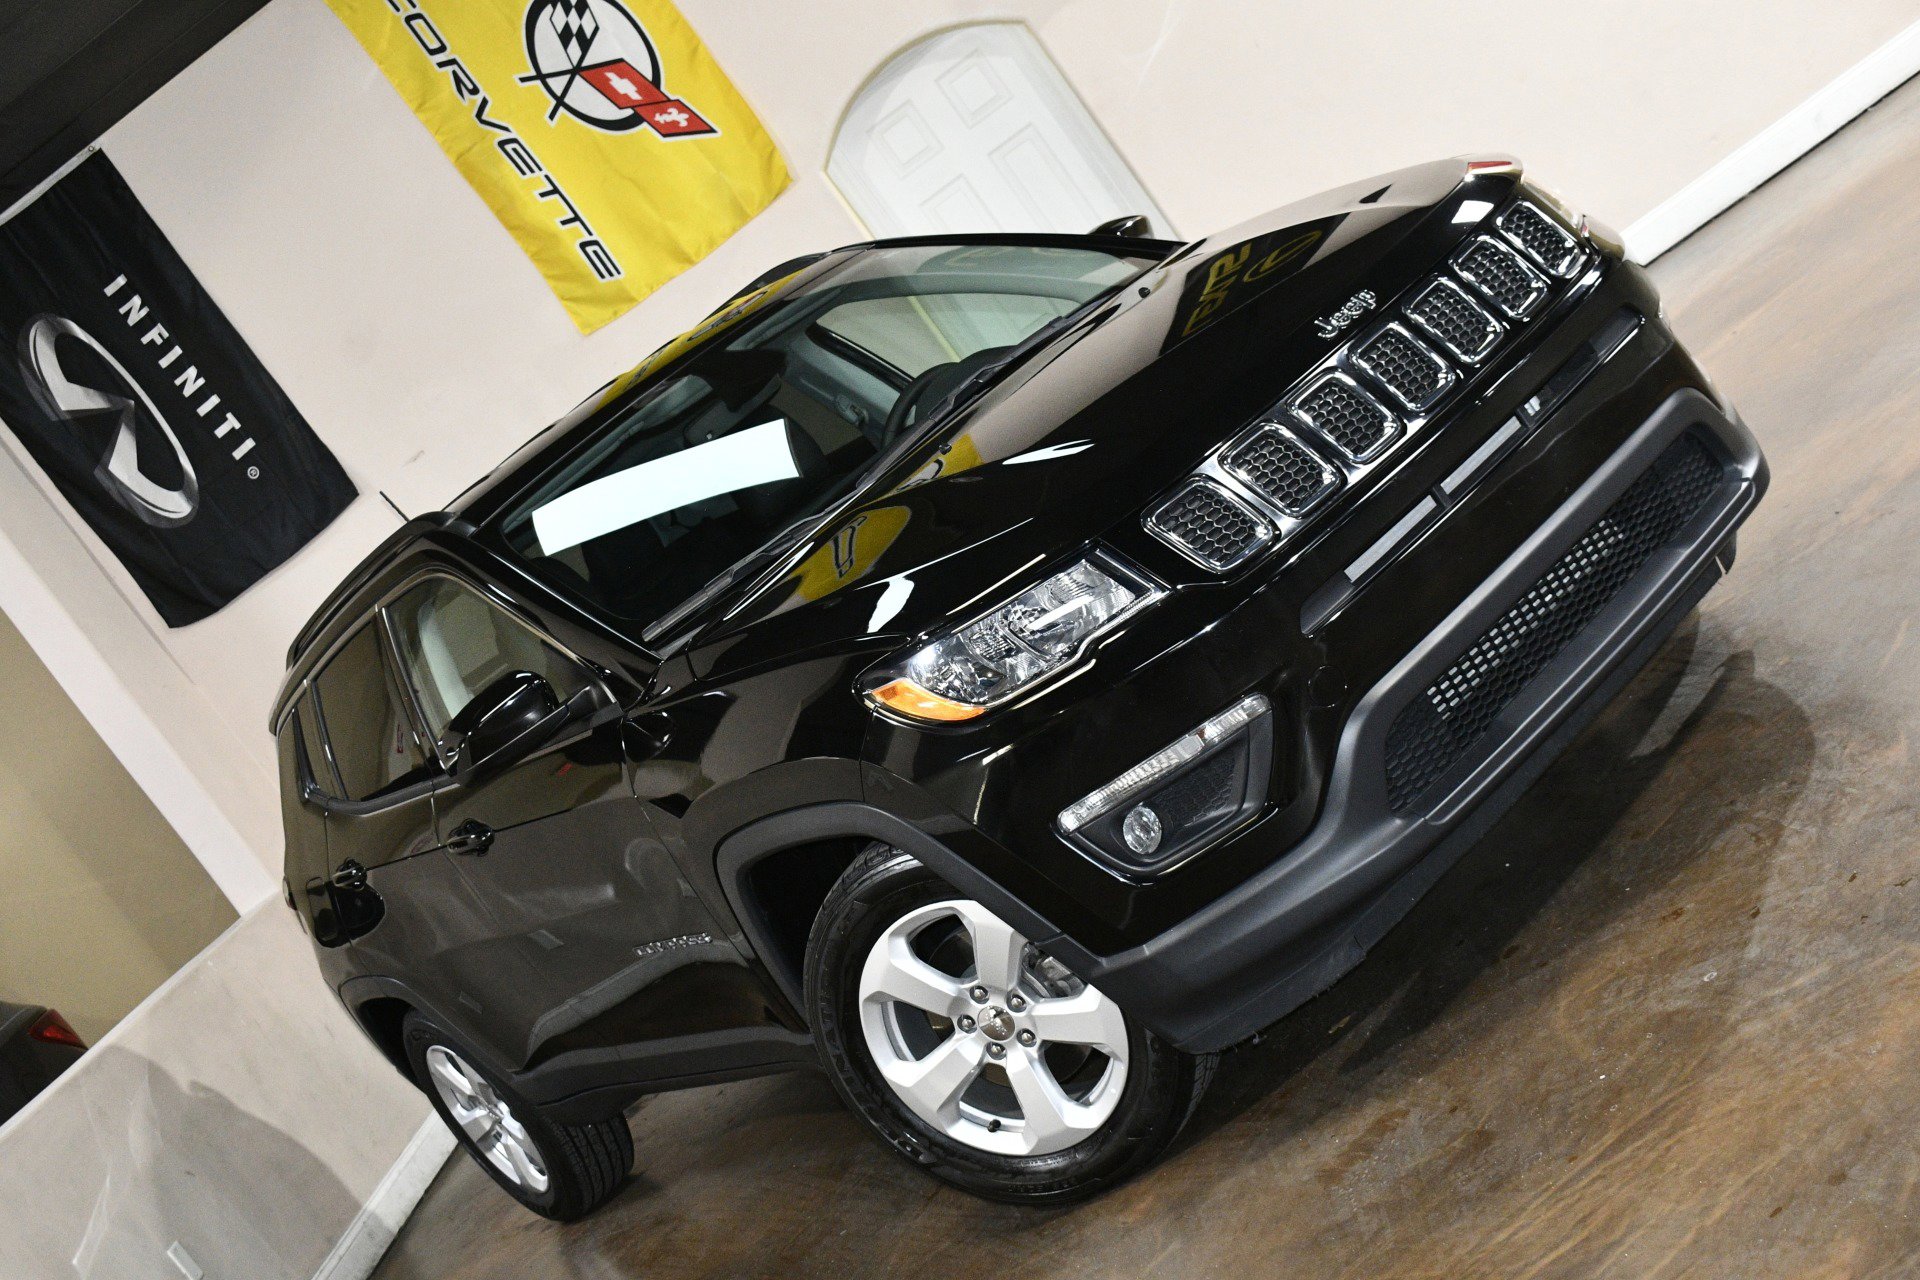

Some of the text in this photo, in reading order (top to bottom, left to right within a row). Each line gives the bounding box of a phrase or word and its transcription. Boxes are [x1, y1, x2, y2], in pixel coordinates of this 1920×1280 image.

[386, 0, 622, 279] ORVETTE
[103, 273, 256, 461] INFINITI
[1314, 289, 1377, 340] Jeep
